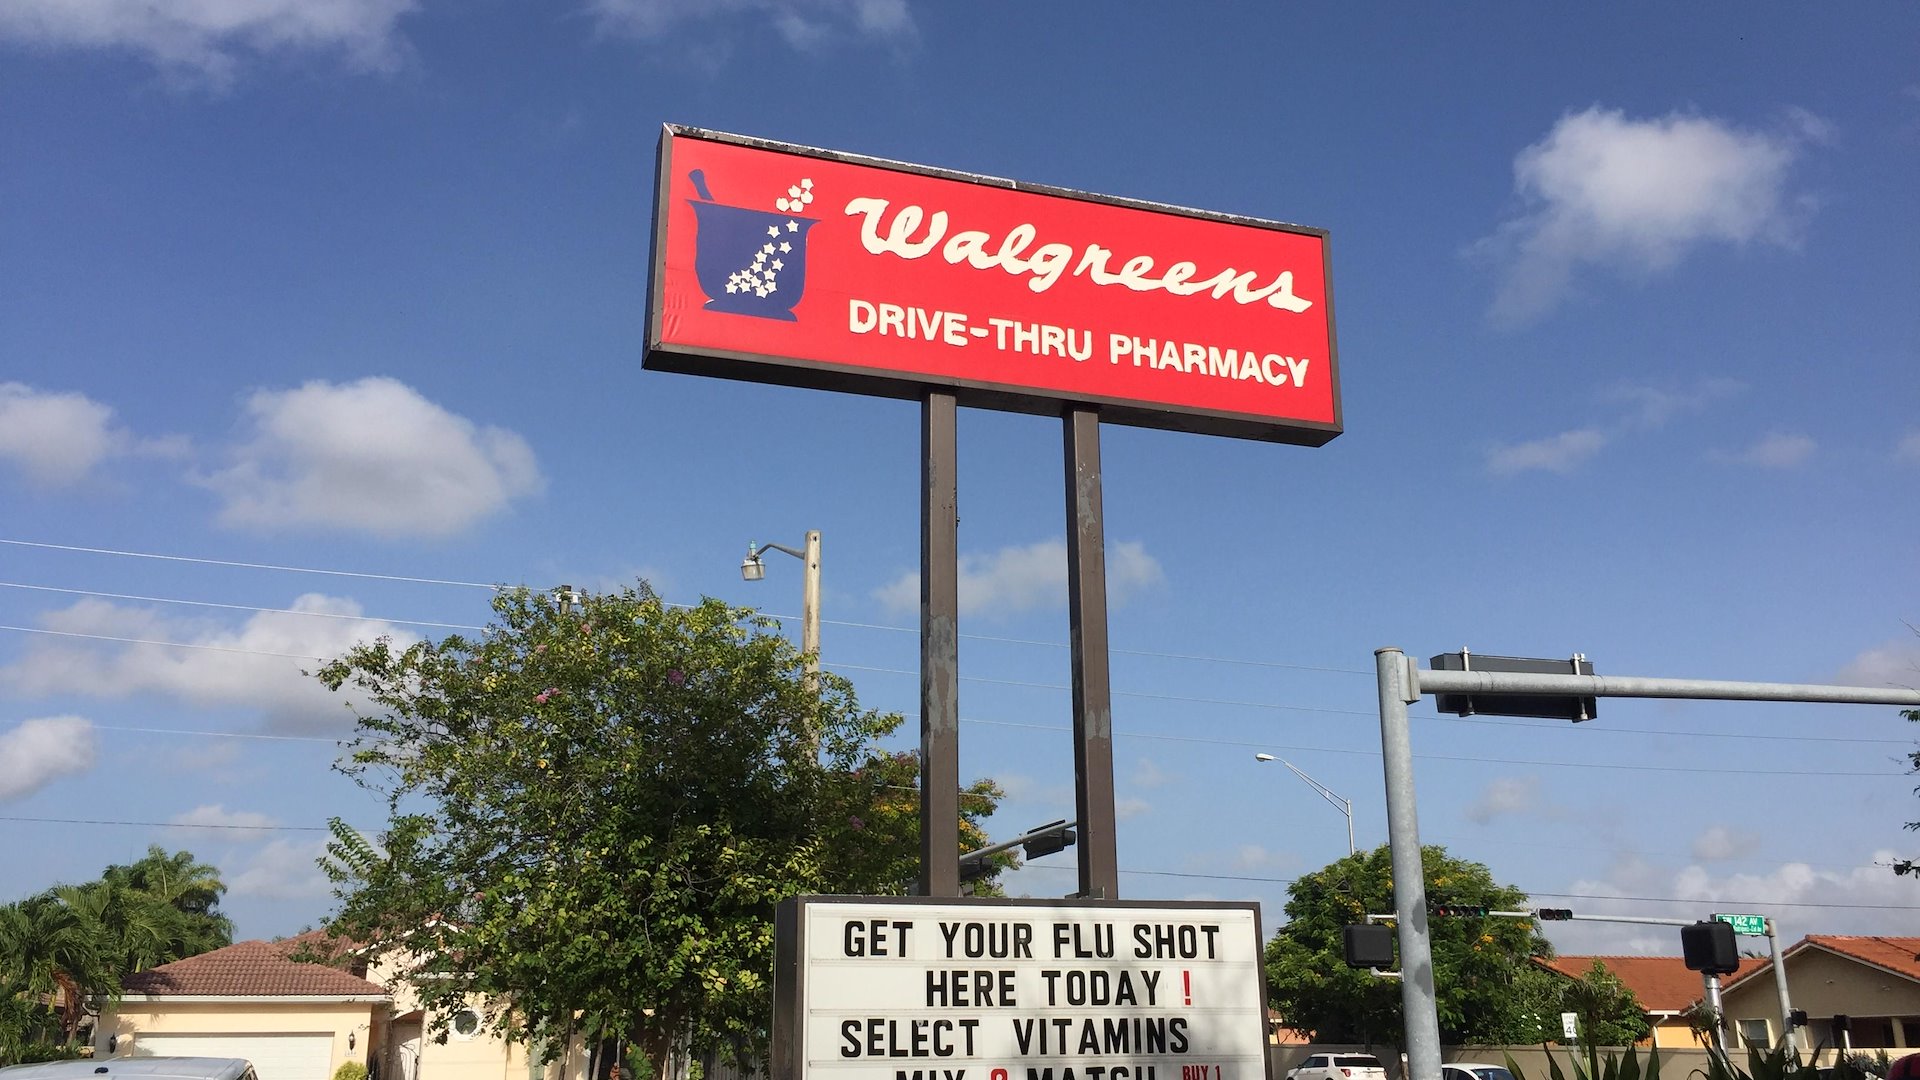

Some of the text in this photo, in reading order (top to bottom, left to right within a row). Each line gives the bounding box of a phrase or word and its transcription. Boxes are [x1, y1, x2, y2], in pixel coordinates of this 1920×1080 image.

[844, 196, 1313, 313] Walgreens
[848, 299, 1310, 388] DRIVE-THRU PHARMACY
[844, 919, 1220, 960] GET YOUR FLU SHOT
[1734, 916, 1748, 926] 142
[926, 970, 1017, 1007] HERE
[841, 1017, 1189, 1058] SELECT VITAMINS
[1182, 1065, 1209, 1080] BUY
